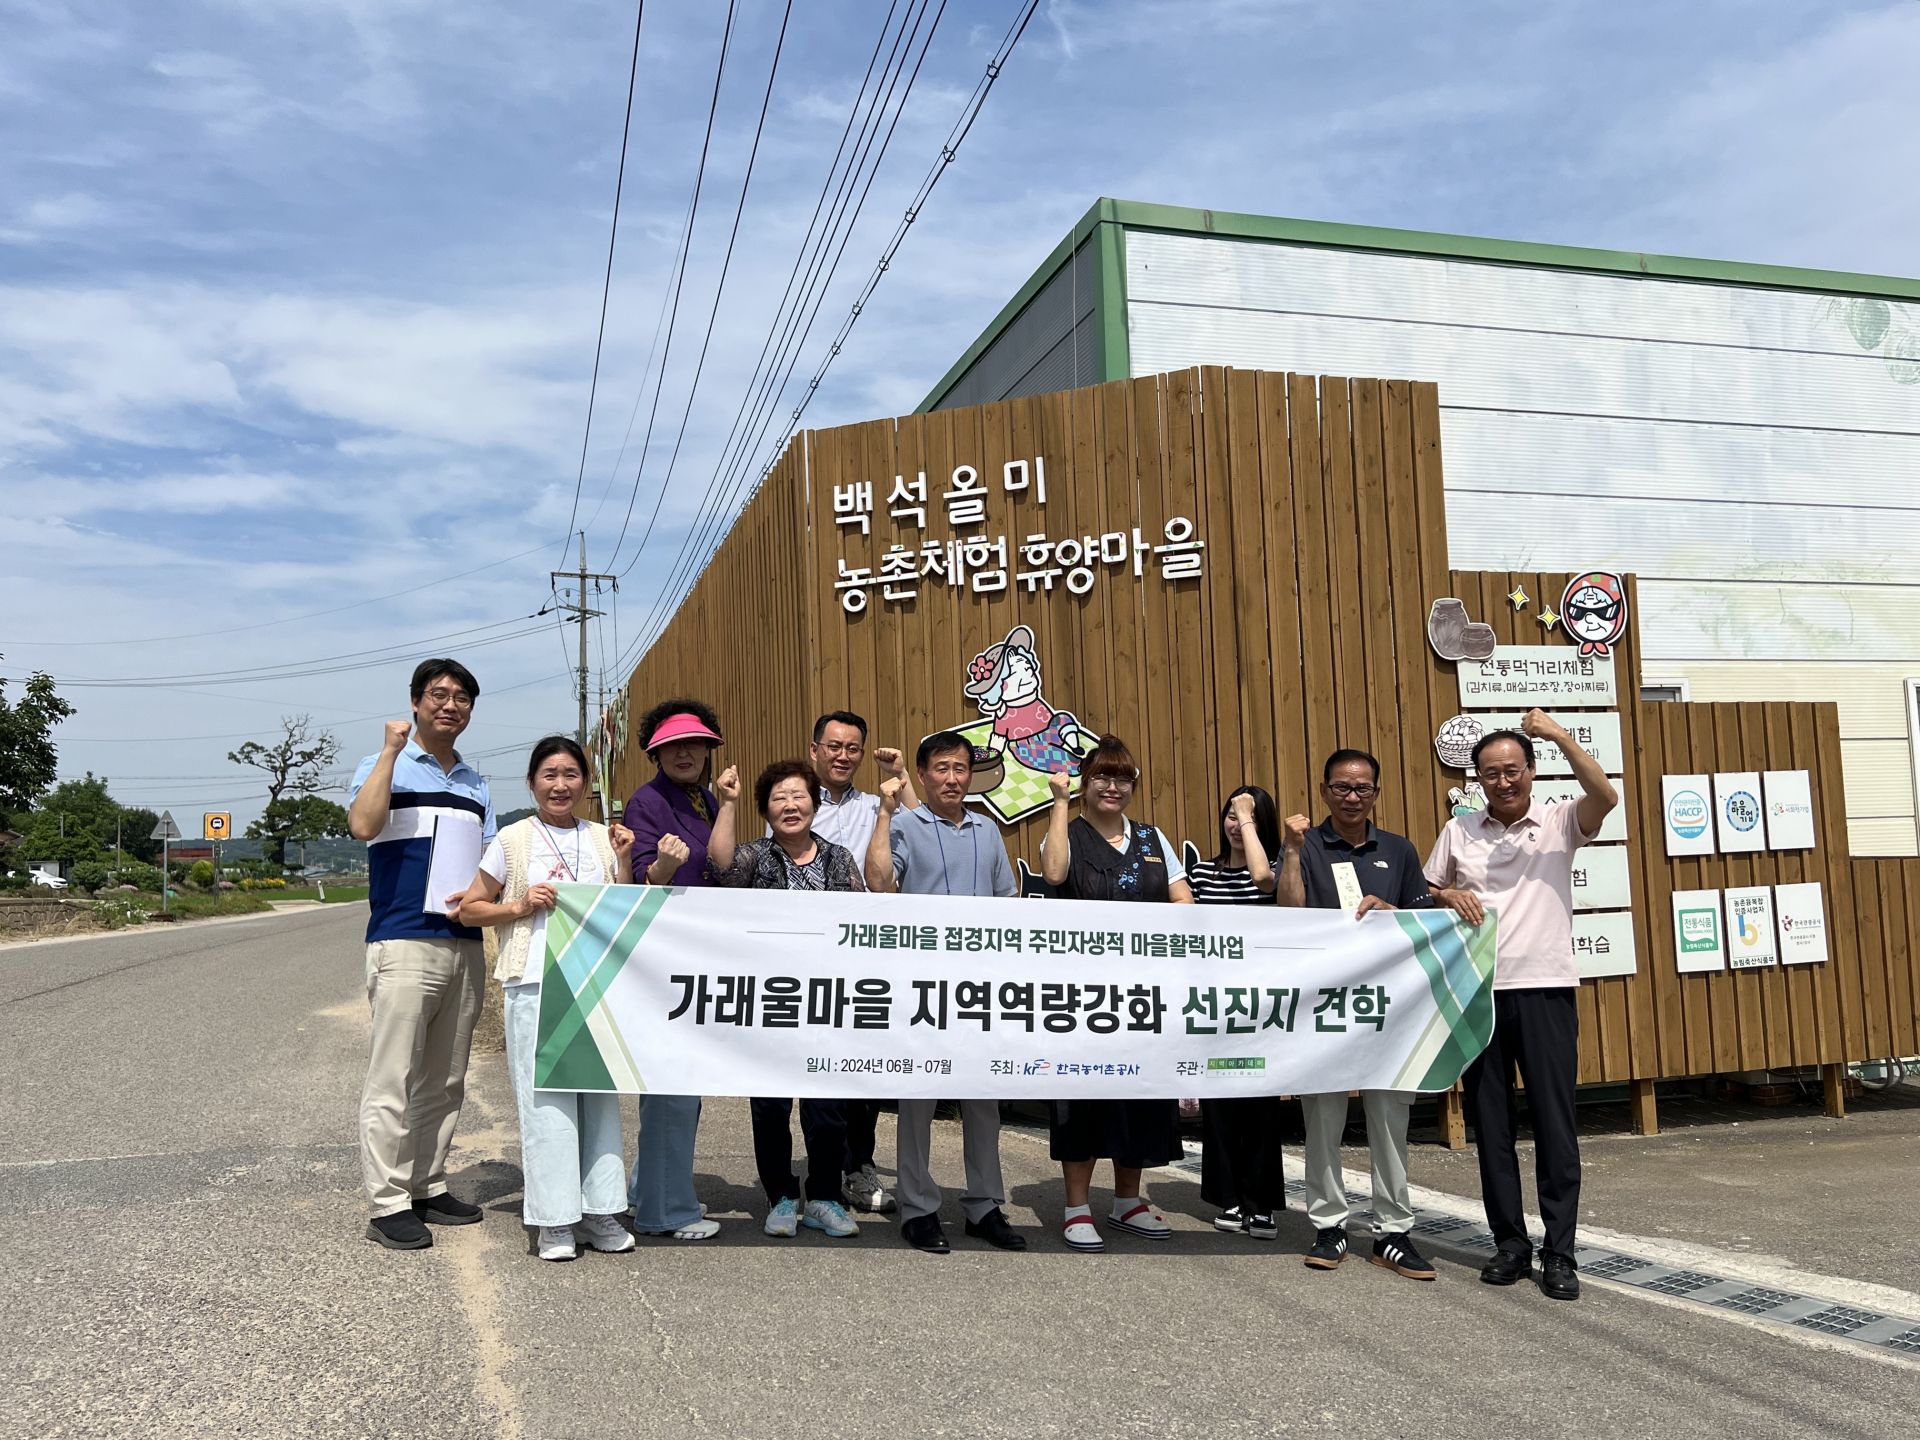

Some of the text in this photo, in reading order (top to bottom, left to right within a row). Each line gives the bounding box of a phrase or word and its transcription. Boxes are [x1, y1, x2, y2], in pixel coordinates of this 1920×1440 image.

[834, 516, 1205, 613] 농촌체험 휴양마을
[1479, 659, 1594, 677] 전통먹거리체험
[1675, 808, 1702, 816] HACCP
[1684, 917, 1712, 928] 전통식품
[838, 924, 1244, 959] 가래울마을 접경지역 주민자생적 마을활력사업
[668, 975, 1391, 1034] 가래울마을 지역역량강화 선진지 견학
[841, 1058, 883, 1074] 2024년
[886, 1059, 914, 1074] 06월
[925, 1060, 952, 1075] 07월
[1056, 1063, 1141, 1076] 한국농어촌공사
